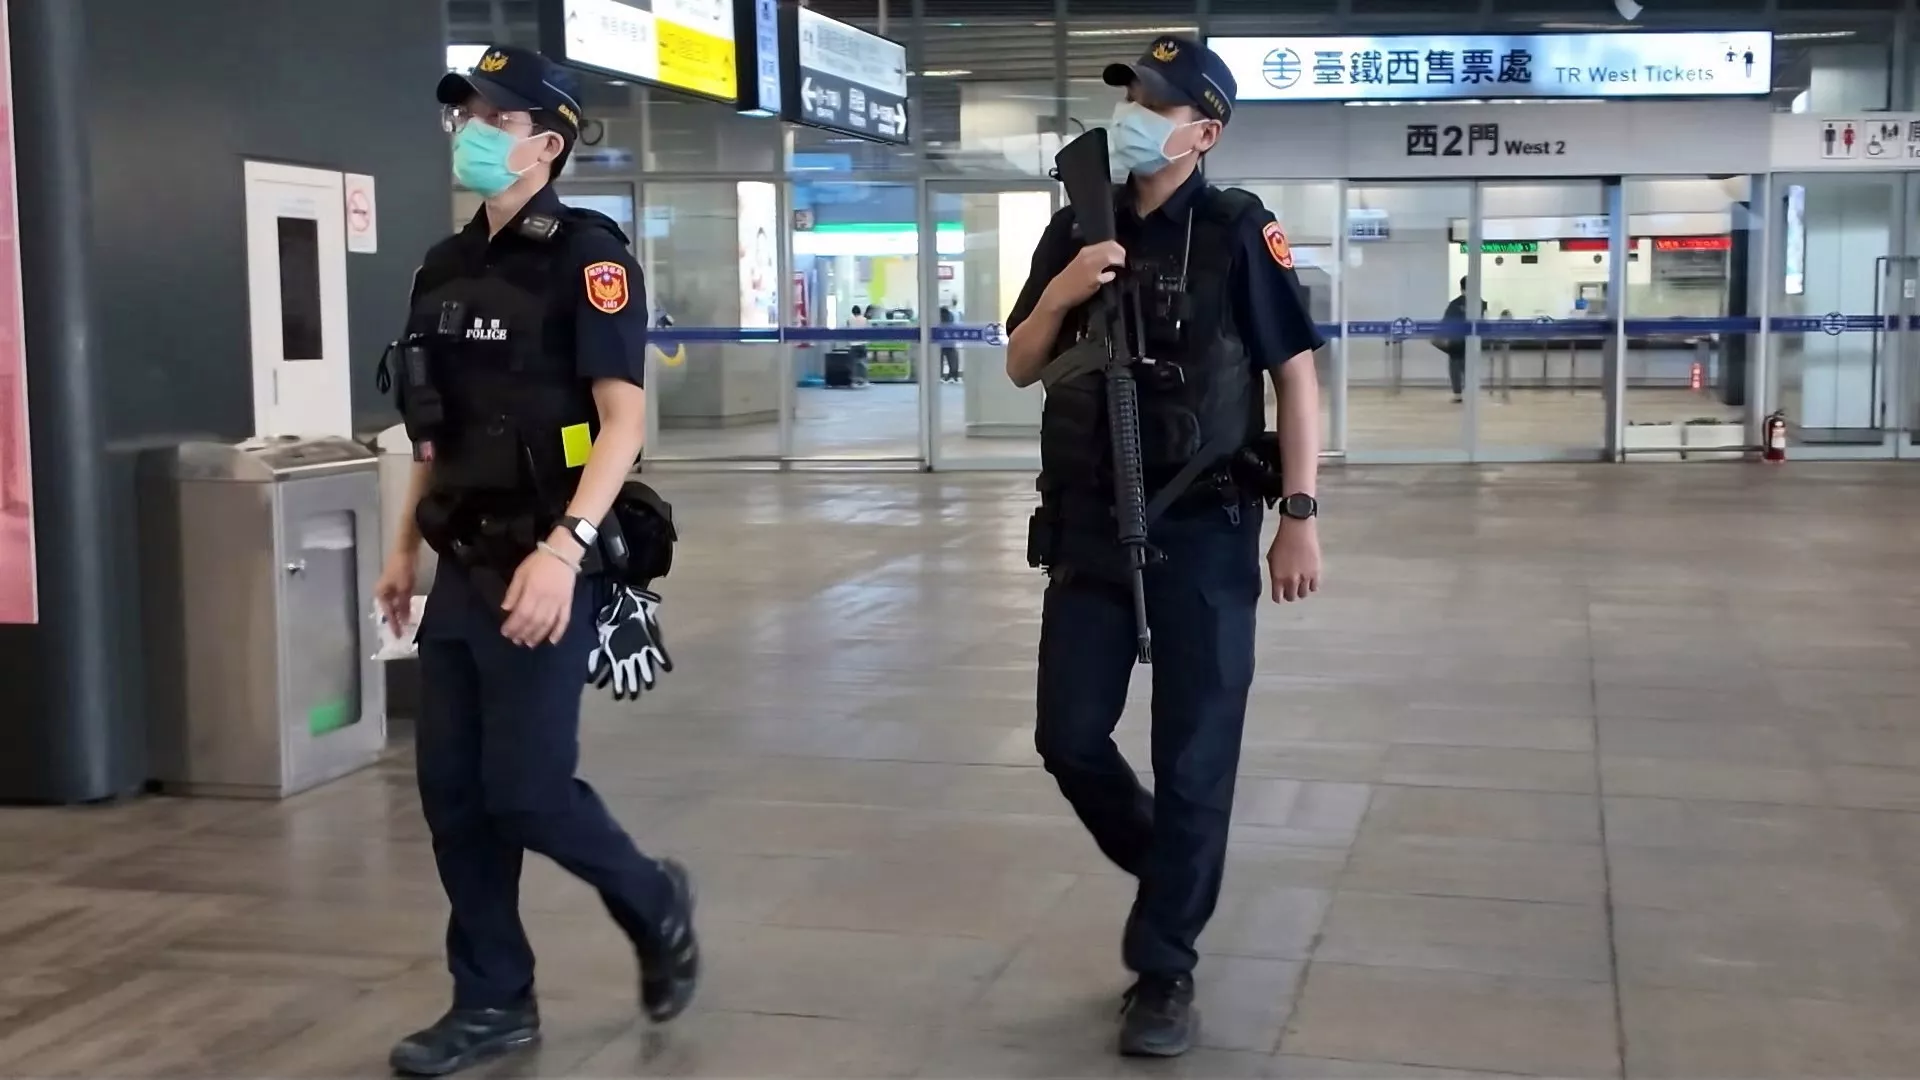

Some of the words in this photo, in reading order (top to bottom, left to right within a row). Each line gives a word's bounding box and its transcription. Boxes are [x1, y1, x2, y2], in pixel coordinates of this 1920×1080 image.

[1313, 49, 1532, 84] 臺鐵西售票處
[1555, 67, 1581, 82] TR
[1588, 66, 1637, 82] West
[1644, 65, 1714, 81] Tickets
[1406, 123, 1499, 156] 西2門
[1504, 140, 1550, 155] West
[1555, 140, 1566, 155] 2
[465, 328, 508, 341] POLICE
